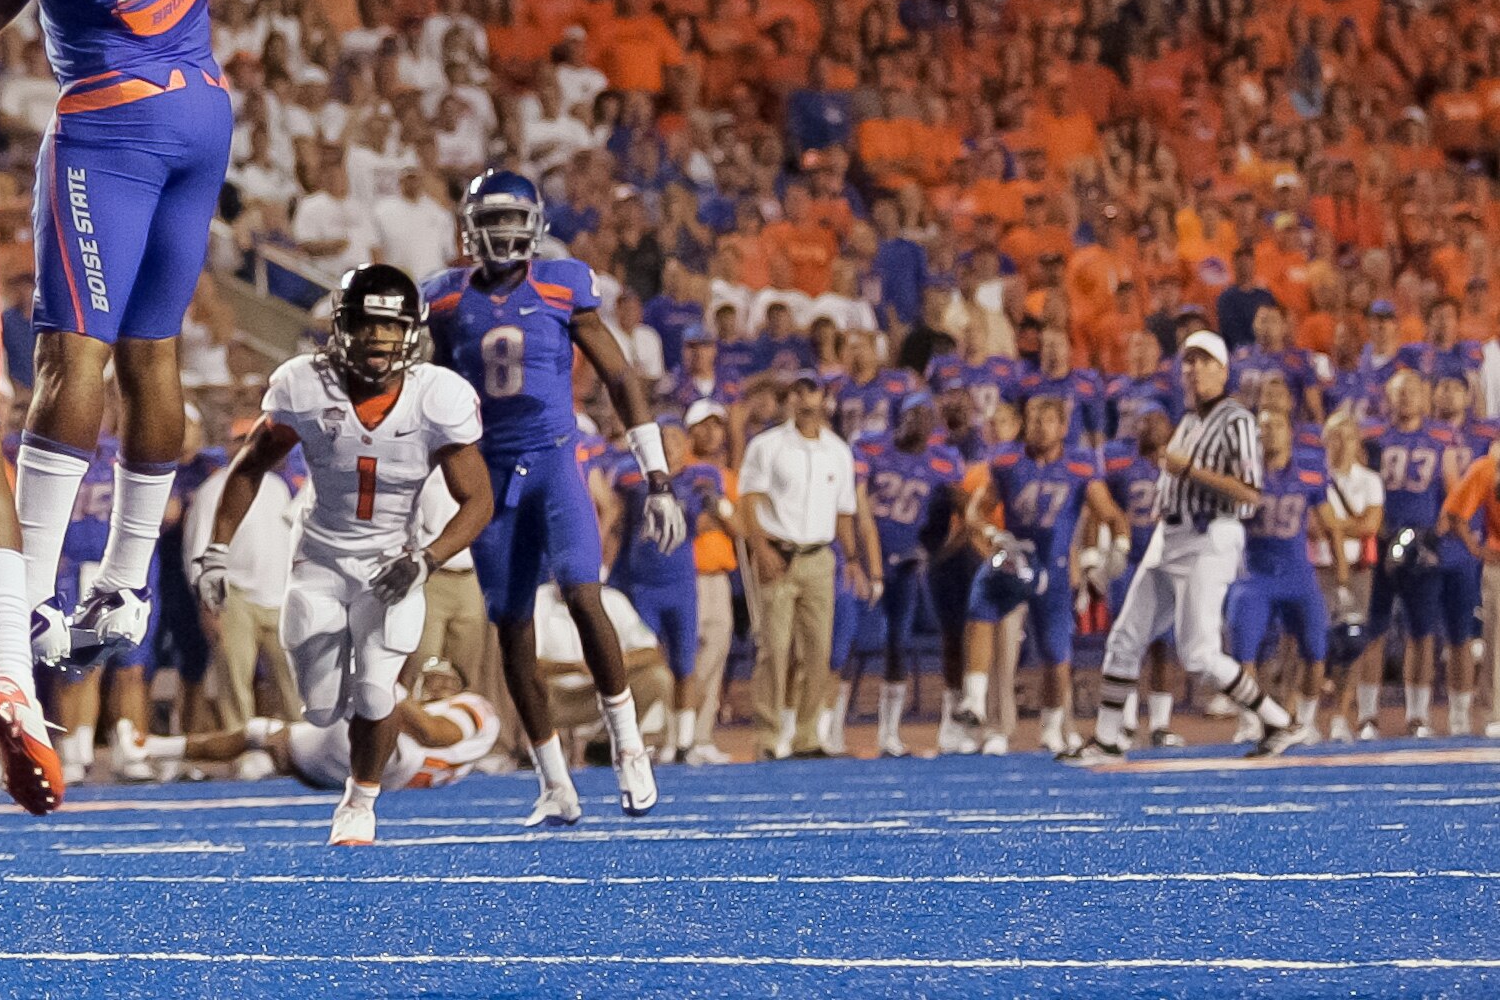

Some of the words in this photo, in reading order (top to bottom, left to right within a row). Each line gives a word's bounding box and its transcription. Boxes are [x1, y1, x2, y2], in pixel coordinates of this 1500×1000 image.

[67, 166, 94, 235] STATE
[78, 237, 110, 313] BOISE
[481, 325, 526, 399] 8
[356, 456, 378, 521] 1
